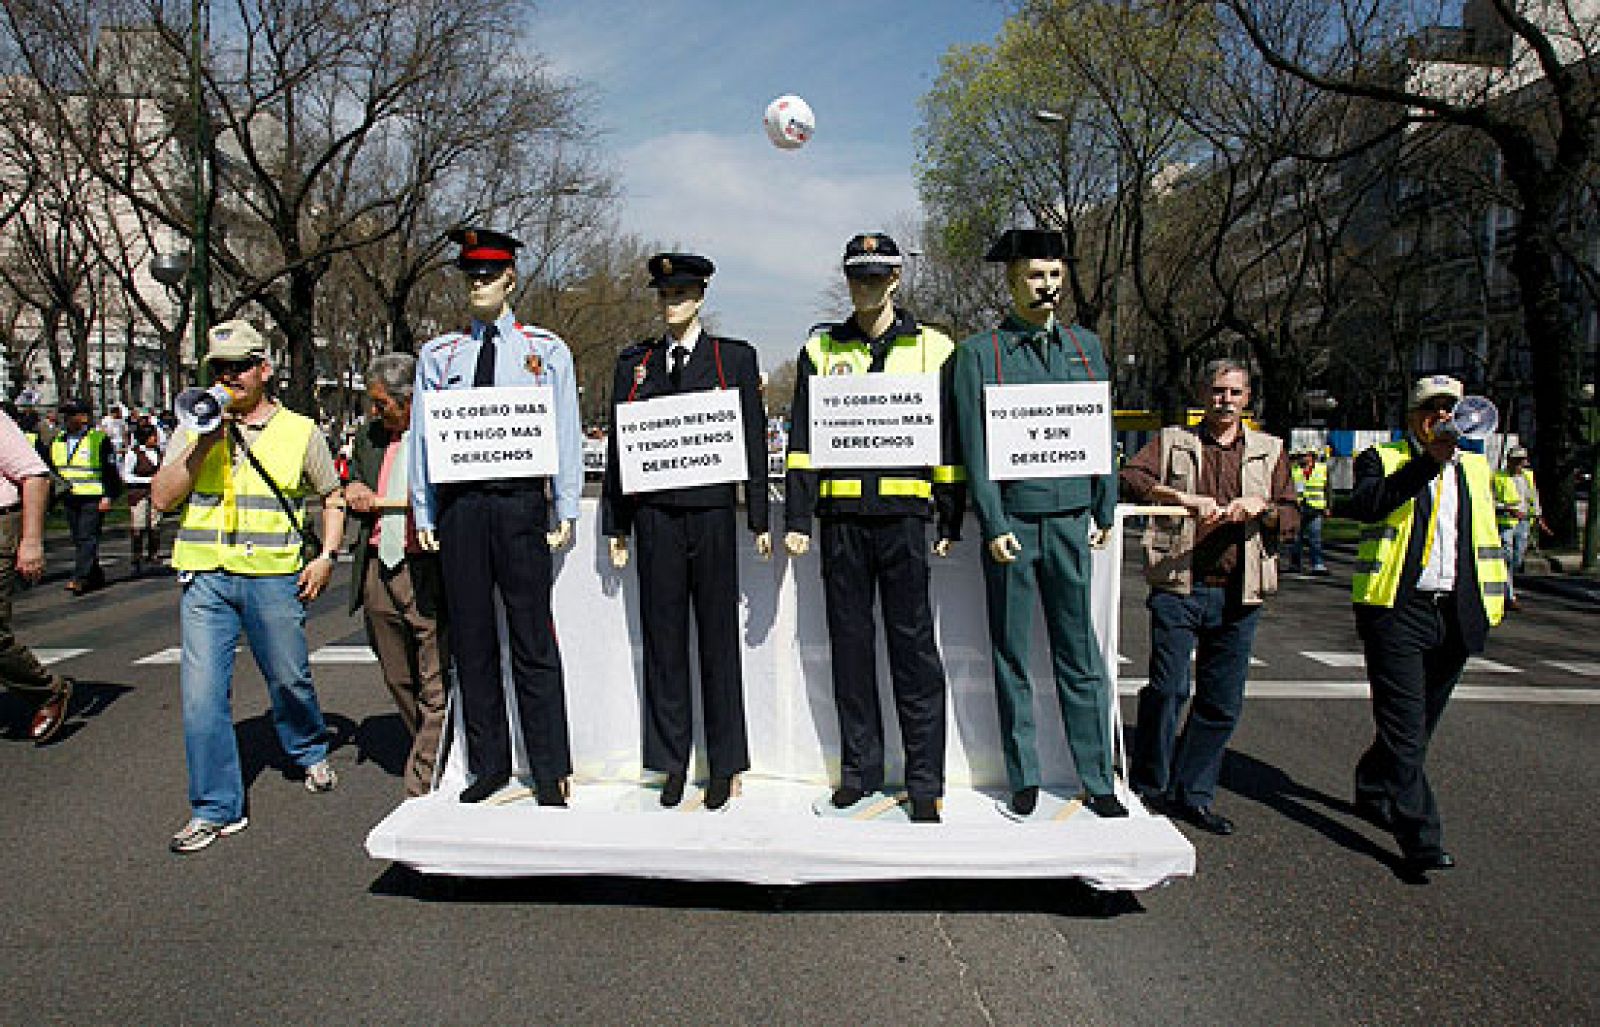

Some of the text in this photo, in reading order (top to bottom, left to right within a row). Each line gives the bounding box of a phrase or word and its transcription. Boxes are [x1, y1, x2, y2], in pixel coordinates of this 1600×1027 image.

[822, 396, 842, 408] YO
[843, 394, 888, 406] COBRO
[430, 407, 453, 420] YO
[456, 404, 511, 420] COBRO
[989, 403, 1105, 419] YO COBRO MENOS
[620, 409, 737, 435] YO COBRO MENOS
[866, 417, 900, 426] TENGO
[439, 429, 449, 444] Y
[453, 426, 508, 442] TENGO
[626, 430, 734, 454] Y TENGO MENOS
[1026, 427, 1072, 441] Y SIN
[831, 436, 915, 449] DERECHOS
[451, 447, 533, 465] DERECHOS
[642, 453, 723, 472] DERECHOS
[1010, 449, 1087, 466] DERECHOS
